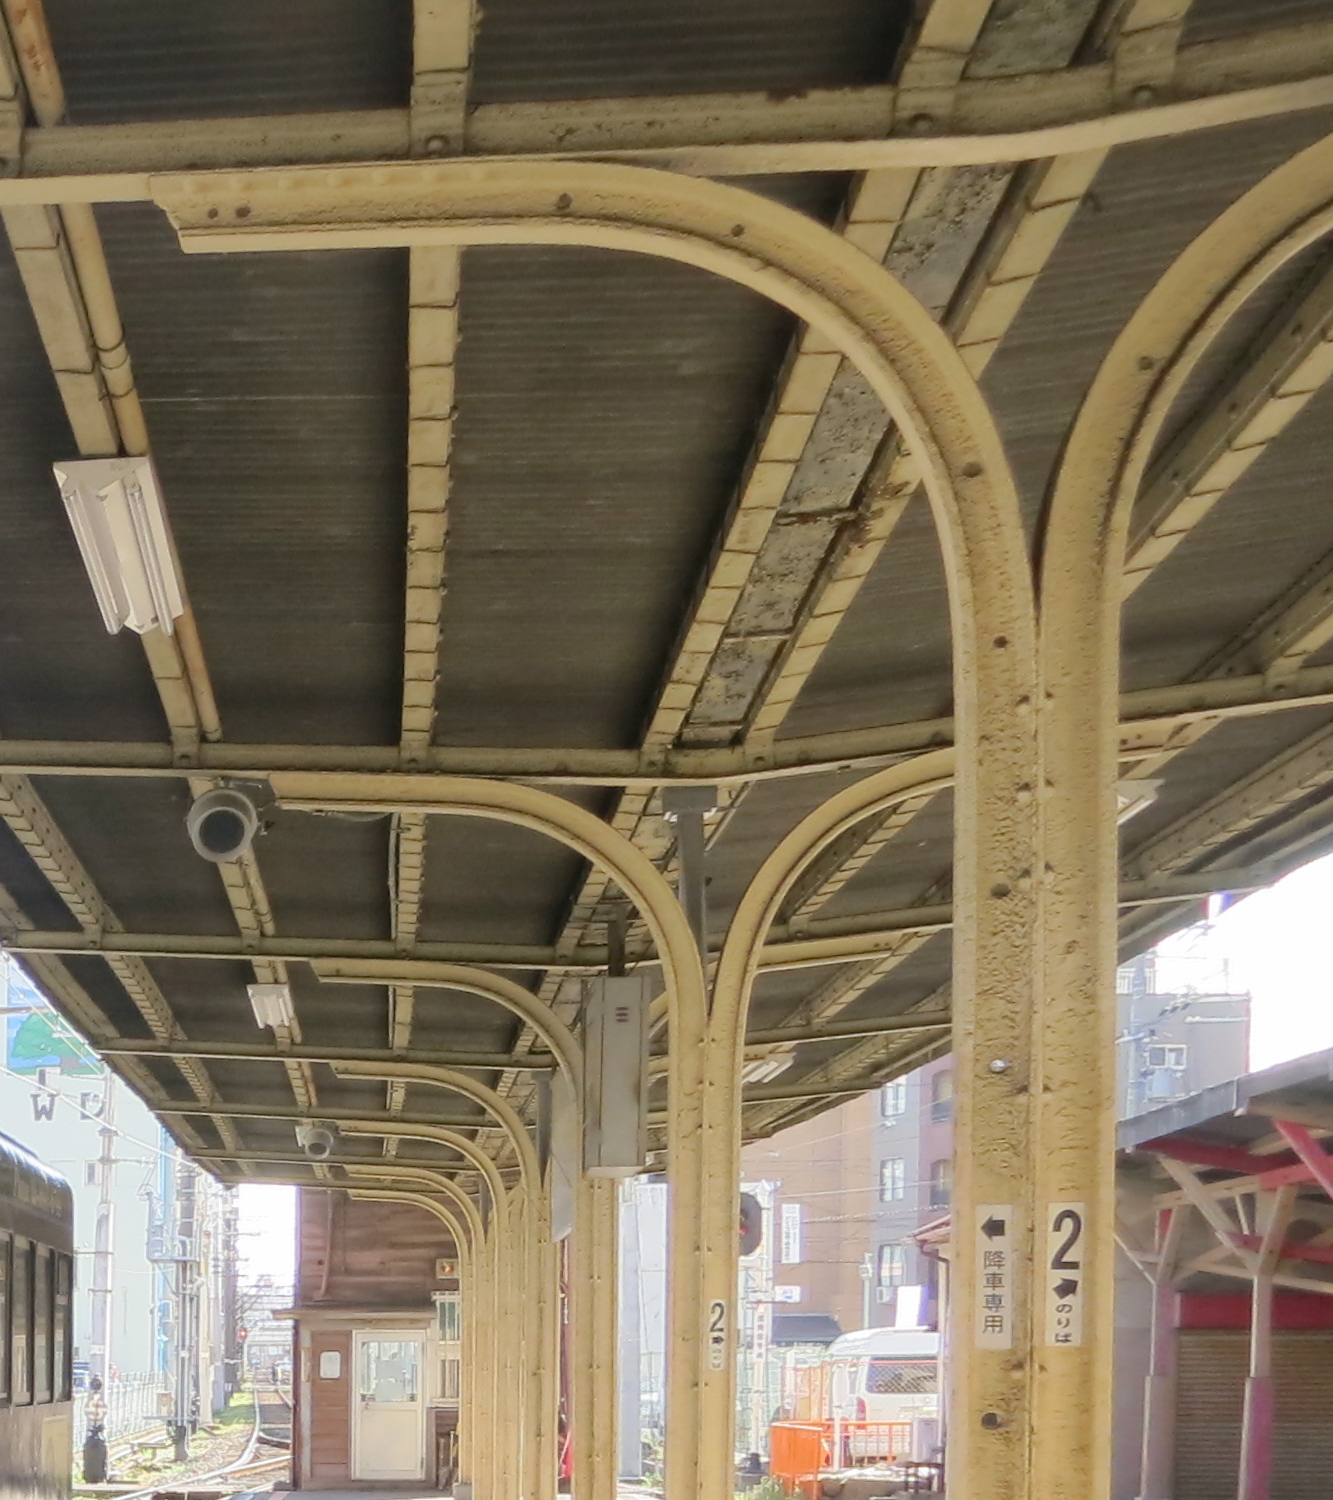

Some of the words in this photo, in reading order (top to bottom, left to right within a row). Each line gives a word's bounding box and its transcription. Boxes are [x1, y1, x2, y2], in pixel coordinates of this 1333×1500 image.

[1050, 1209, 1082, 1270] 2
[709, 1302, 725, 1333] 2
[982, 1250, 1006, 1334] 降車専用
